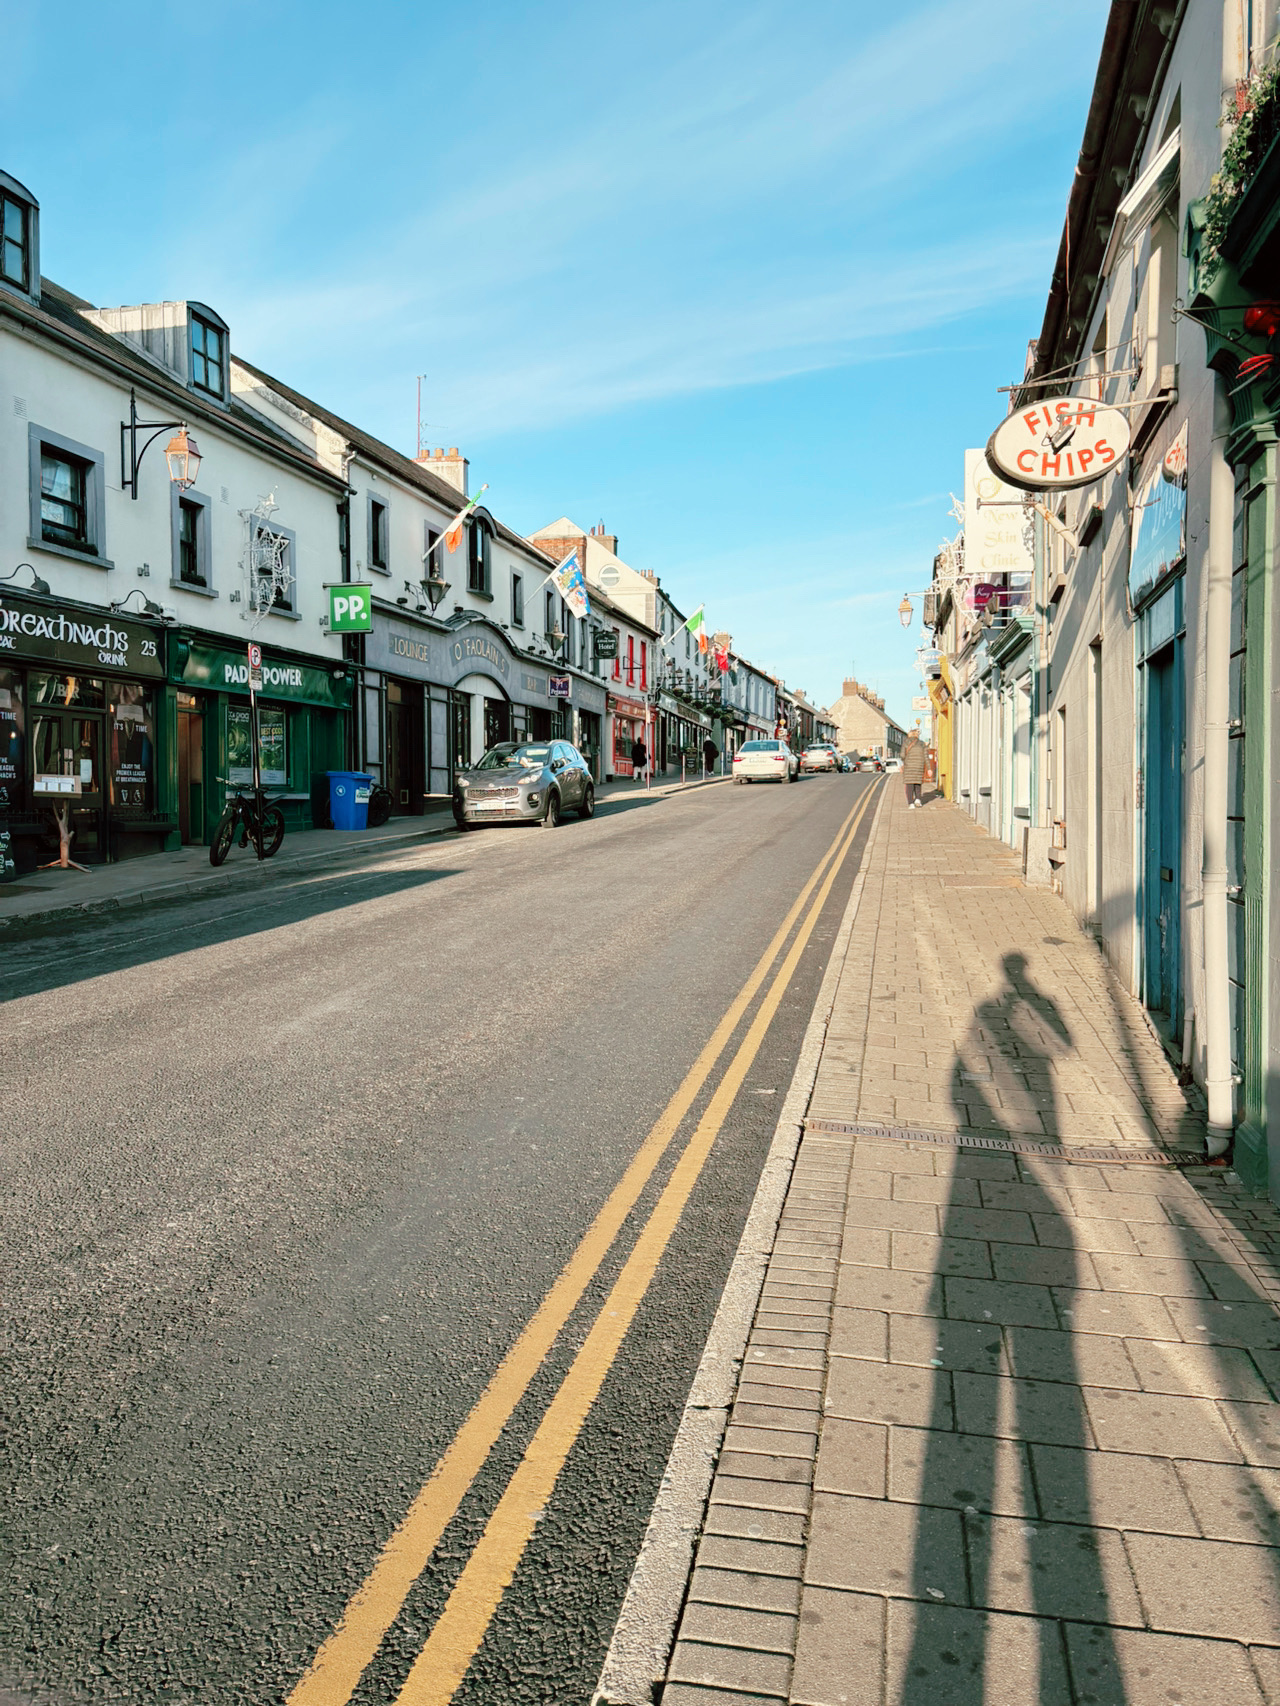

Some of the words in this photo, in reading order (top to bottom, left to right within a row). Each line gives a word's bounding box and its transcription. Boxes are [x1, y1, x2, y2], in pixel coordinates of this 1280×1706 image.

[1023, 402, 1097, 436] FISH
[1017, 439, 1115, 477] CHIPS
[984, 509, 1018, 524] New
[984, 531, 1017, 548] Skin
[981, 553, 1020, 569] Clinic
[141, 640, 157, 657] 25
[394, 637, 428, 661] LOUNGE
[0, 711, 17, 721] TIME
[113, 722, 124, 731] IT'S
[135, 724, 148, 733] TIME
